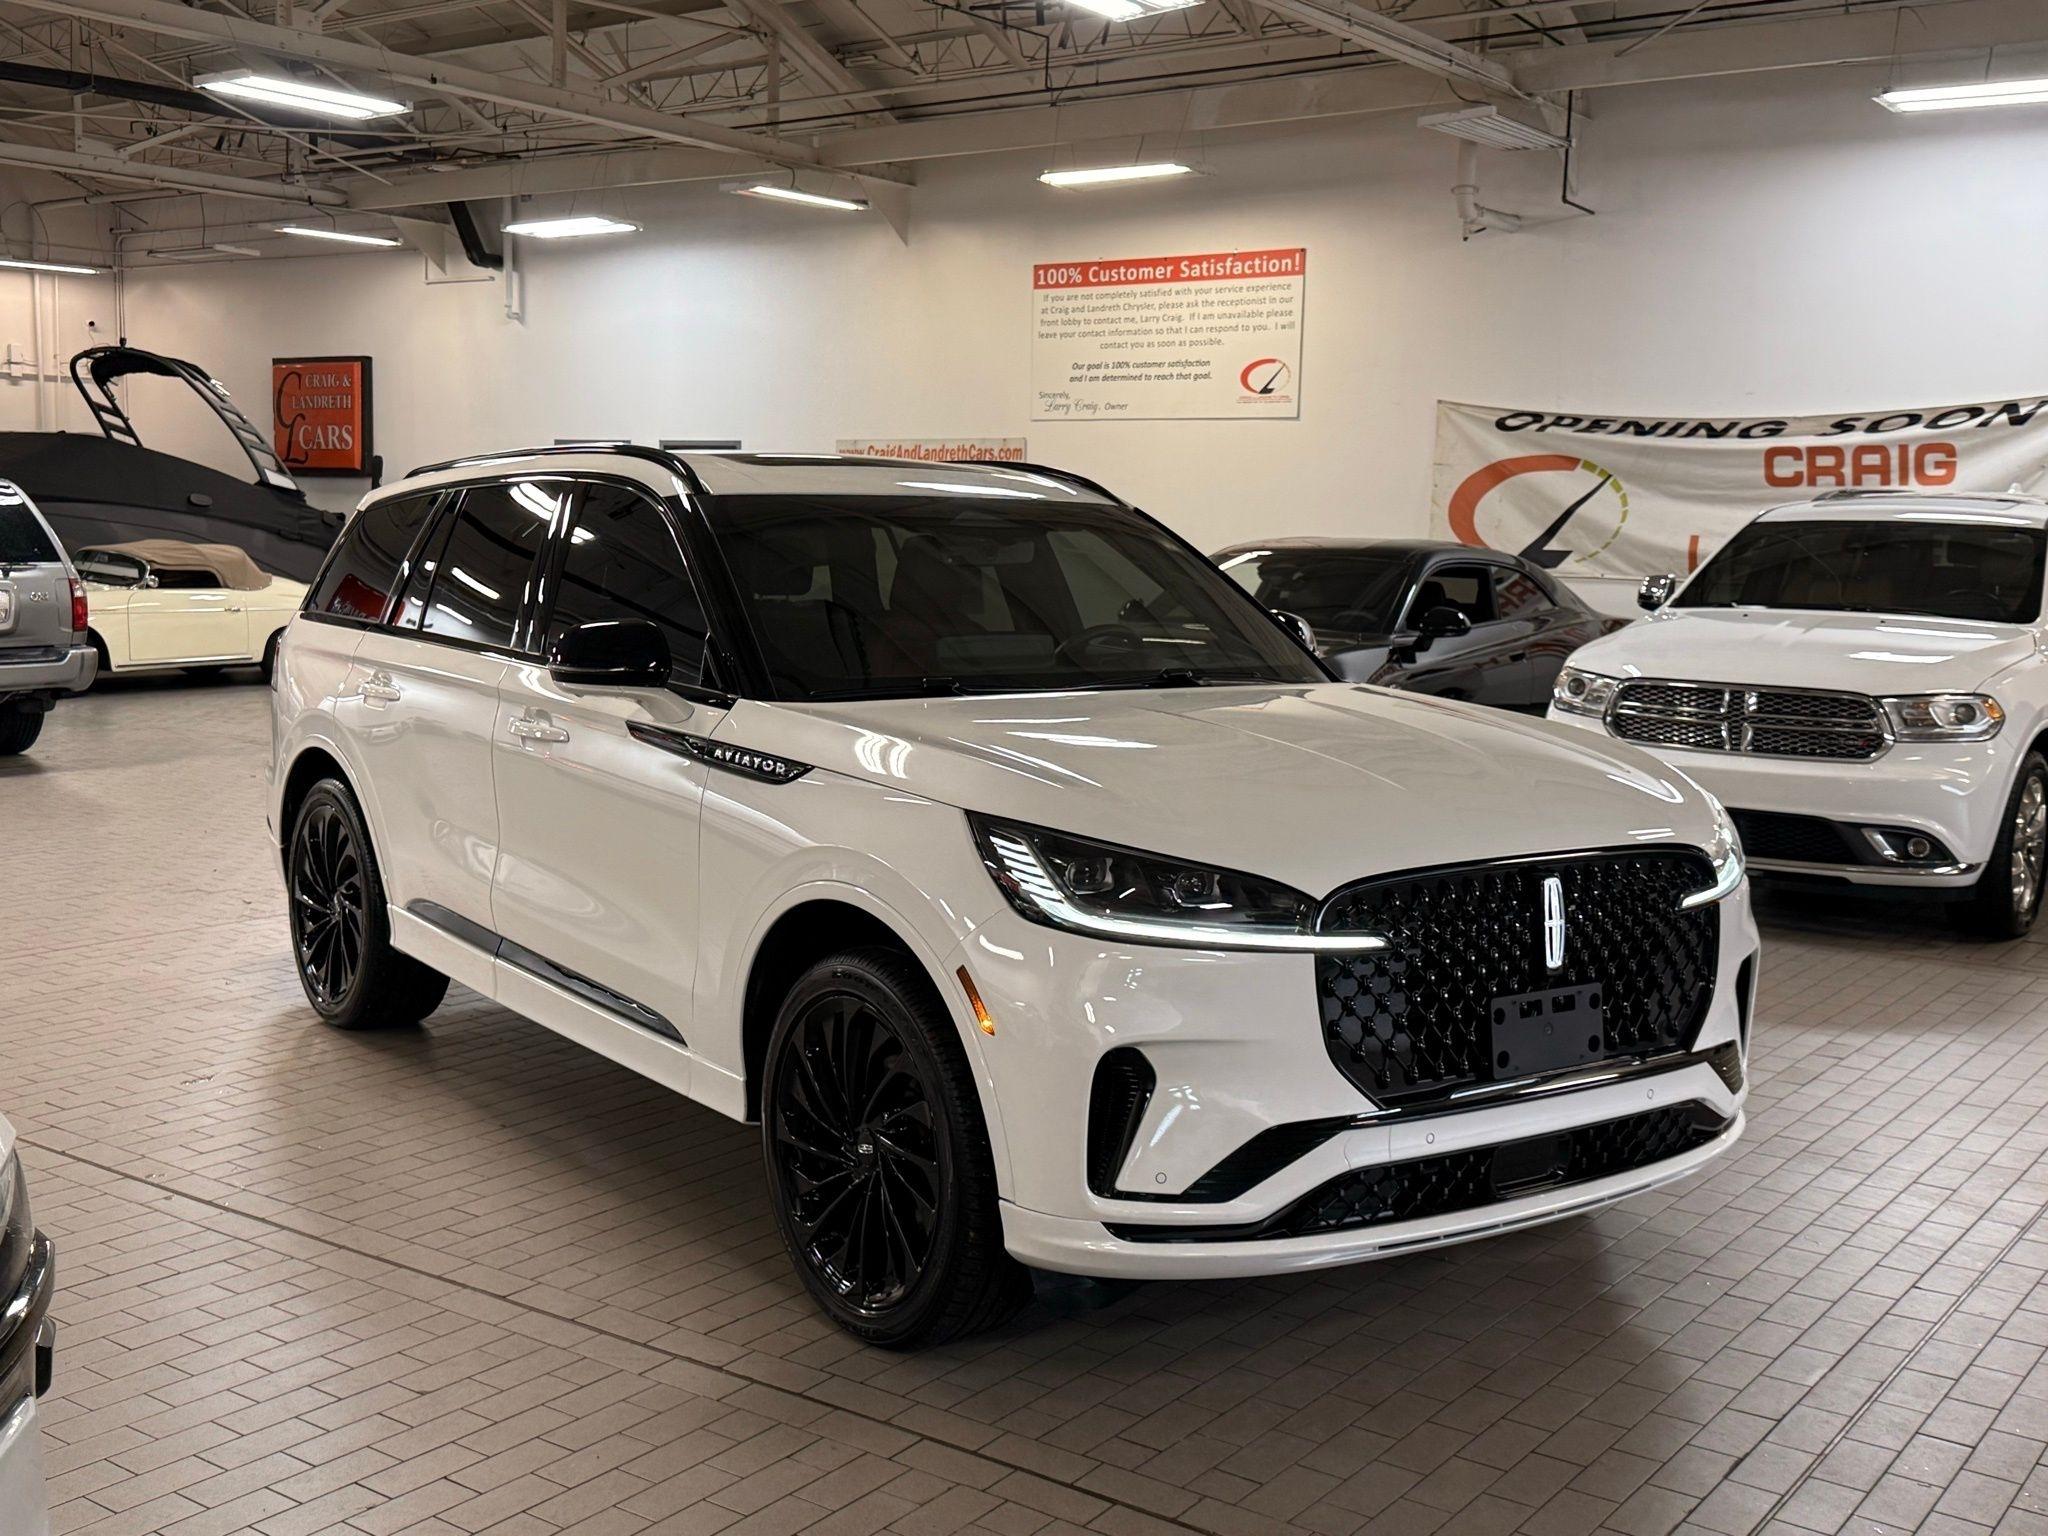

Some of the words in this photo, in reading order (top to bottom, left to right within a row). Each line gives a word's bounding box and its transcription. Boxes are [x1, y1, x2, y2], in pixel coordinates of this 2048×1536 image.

[1037, 267, 1082, 286] 100%
[1088, 263, 1174, 283] Customer
[1180, 253, 1300, 280] Satisfaction!
[1043, 294, 1049, 302] If
[1050, 295, 1064, 303] you
[1096, 290, 1138, 300] completely
[1139, 288, 1172, 298] satisfied
[1174, 286, 1192, 296] with
[1194, 287, 1213, 296] your
[1215, 284, 1243, 294] service
[1246, 283, 1292, 293] experience
[1050, 306, 1070, 316] Craig
[1071, 305, 1085, 313] and
[1087, 303, 1121, 313] Landreth
[1123, 302, 1156, 312] Chrysler,
[1158, 300, 1184, 310] please
[1186, 299, 1199, 308] ask
[1201, 299, 1215, 308] the
[1217, 296, 1266, 307] receptionist
[1269, 296, 1277, 304] in
[1279, 296, 1294, 304] our
[1040, 319, 1059, 327] front
[1061, 318, 1081, 328] lobby
[1083, 318, 1092, 326] to
[1093, 317, 1122, 325] contact
[1140, 315, 1160, 325] Larry
[1162, 313, 1185, 324] Craig.
[1189, 312, 1196, 321] If
[1217, 309, 1265, 320] unavailable
[1266, 308, 1293, 319] please
[1038, 331, 1057, 339] leave
[1059, 331, 1076, 340] your
[1078, 329, 1106, 338] contact
[1108, 327, 1153, 337] information
[1166, 326, 1183, 335] that
[1189, 326, 1204, 334] can
[1206, 323, 1239, 334] respond
[1241, 324, 1250, 332] to
[1252, 323, 1271, 333] you.
[1280, 321, 1296, 330] will
[1100, 341, 1129, 350] contact
[1130, 342, 1145, 351] you
[1157, 340, 1177, 348] soon
[1188, 338, 1225, 348] possible.
[1072, 362, 1085, 371] Our
[1086, 361, 1103, 372] goal
[1104, 361, 1110, 370] is
[1111, 360, 1131, 370] 100%
[1132, 360, 1166, 369] customer
[1167, 359, 1211, 370] satisfaction
[305, 373, 339, 388] CRAIG
[342, 375, 352, 387] &
[1069, 374, 1083, 383] and
[1101, 373, 1142, 382] determined
[1144, 373, 1152, 381] to
[1154, 372, 1174, 381] reach
[1176, 372, 1192, 380] that
[1193, 371, 1213, 382] goal.
[292, 394, 352, 409] LANDRETH
[1038, 391, 1071, 400] Sincerely,
[1044, 399, 1071, 415] Larry
[1104, 402, 1128, 411] Owner
[1495, 411, 1788, 439] OPENING
[1814, 400, 2048, 437] SOON
[299, 424, 353, 450] CARS
[839, 443, 1024, 461] CraigAndLandrethCars.com
[1764, 442, 1958, 487] CRAIG
[713, 748, 786, 775] AVIATOR
